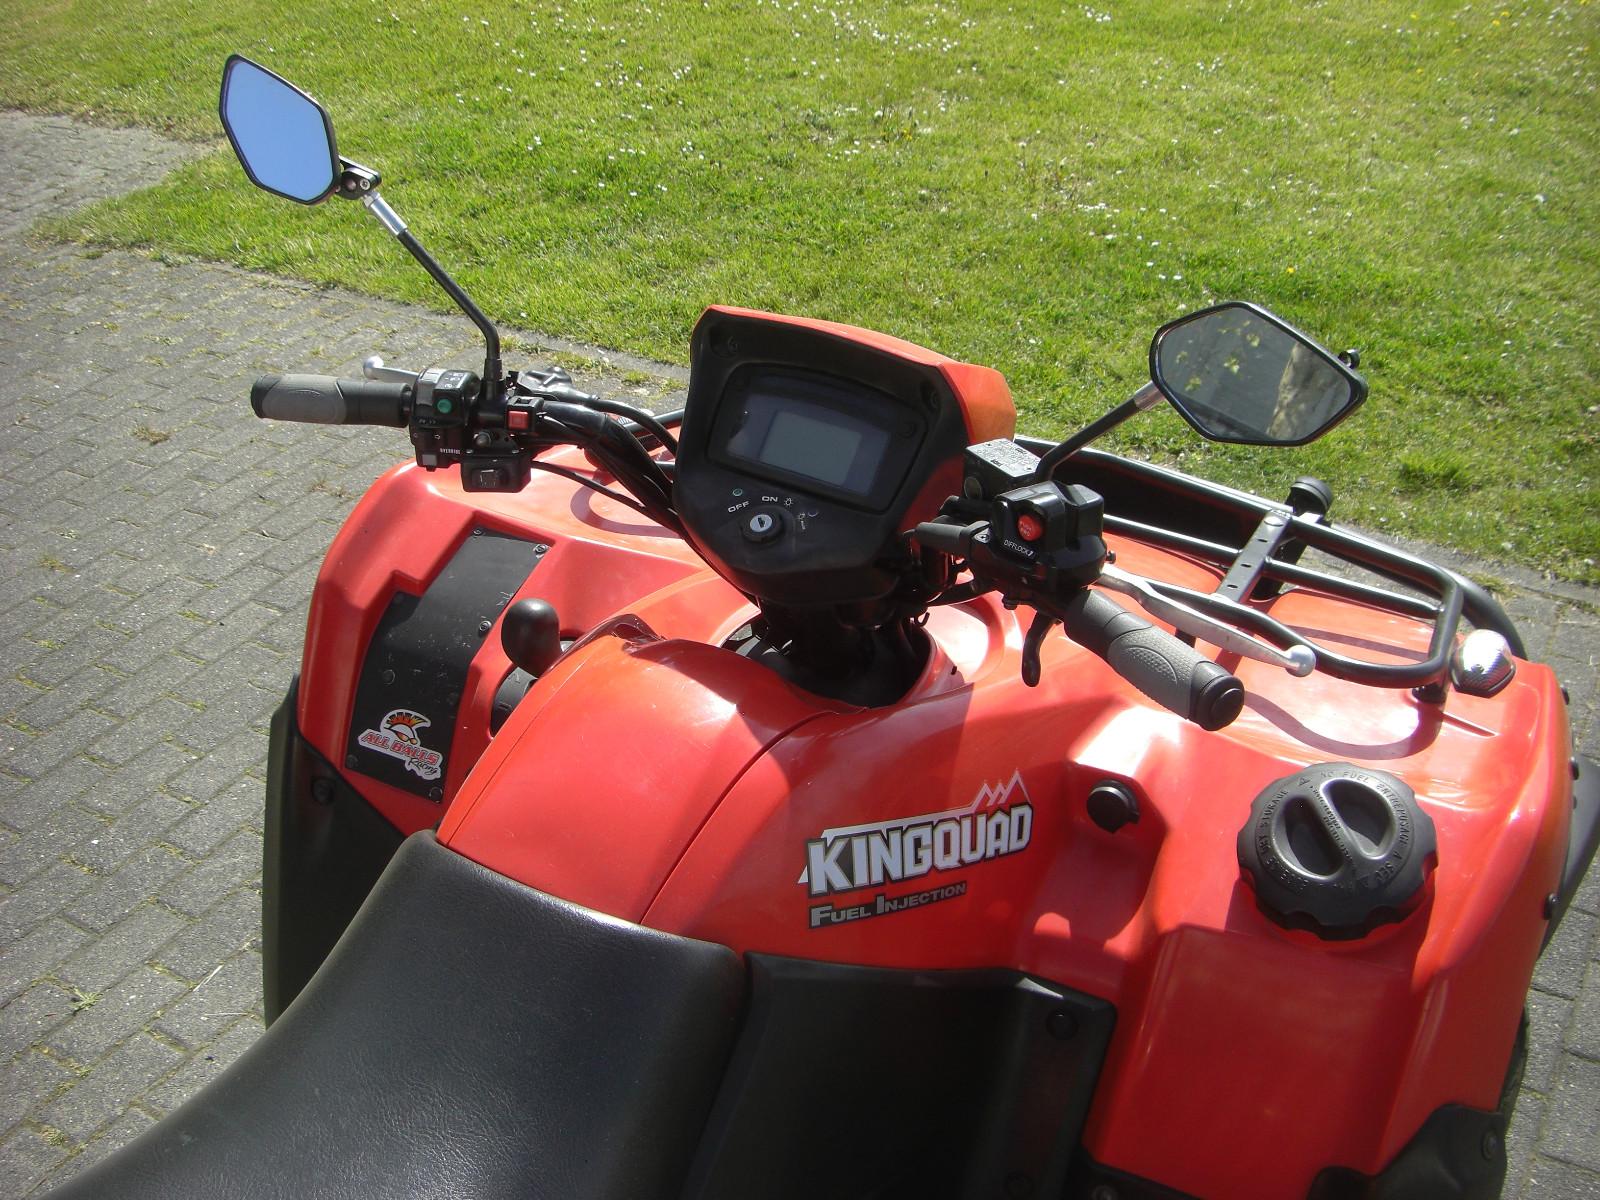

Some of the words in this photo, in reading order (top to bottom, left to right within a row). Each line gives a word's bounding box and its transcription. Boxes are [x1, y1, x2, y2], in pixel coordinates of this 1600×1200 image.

[727, 501, 749, 513] OFF
[361, 731, 389, 750] ALL
[391, 740, 440, 766] BALLS
[1343, 771, 1370, 784] FUEL
[808, 802, 1033, 897] KINGQUAD
